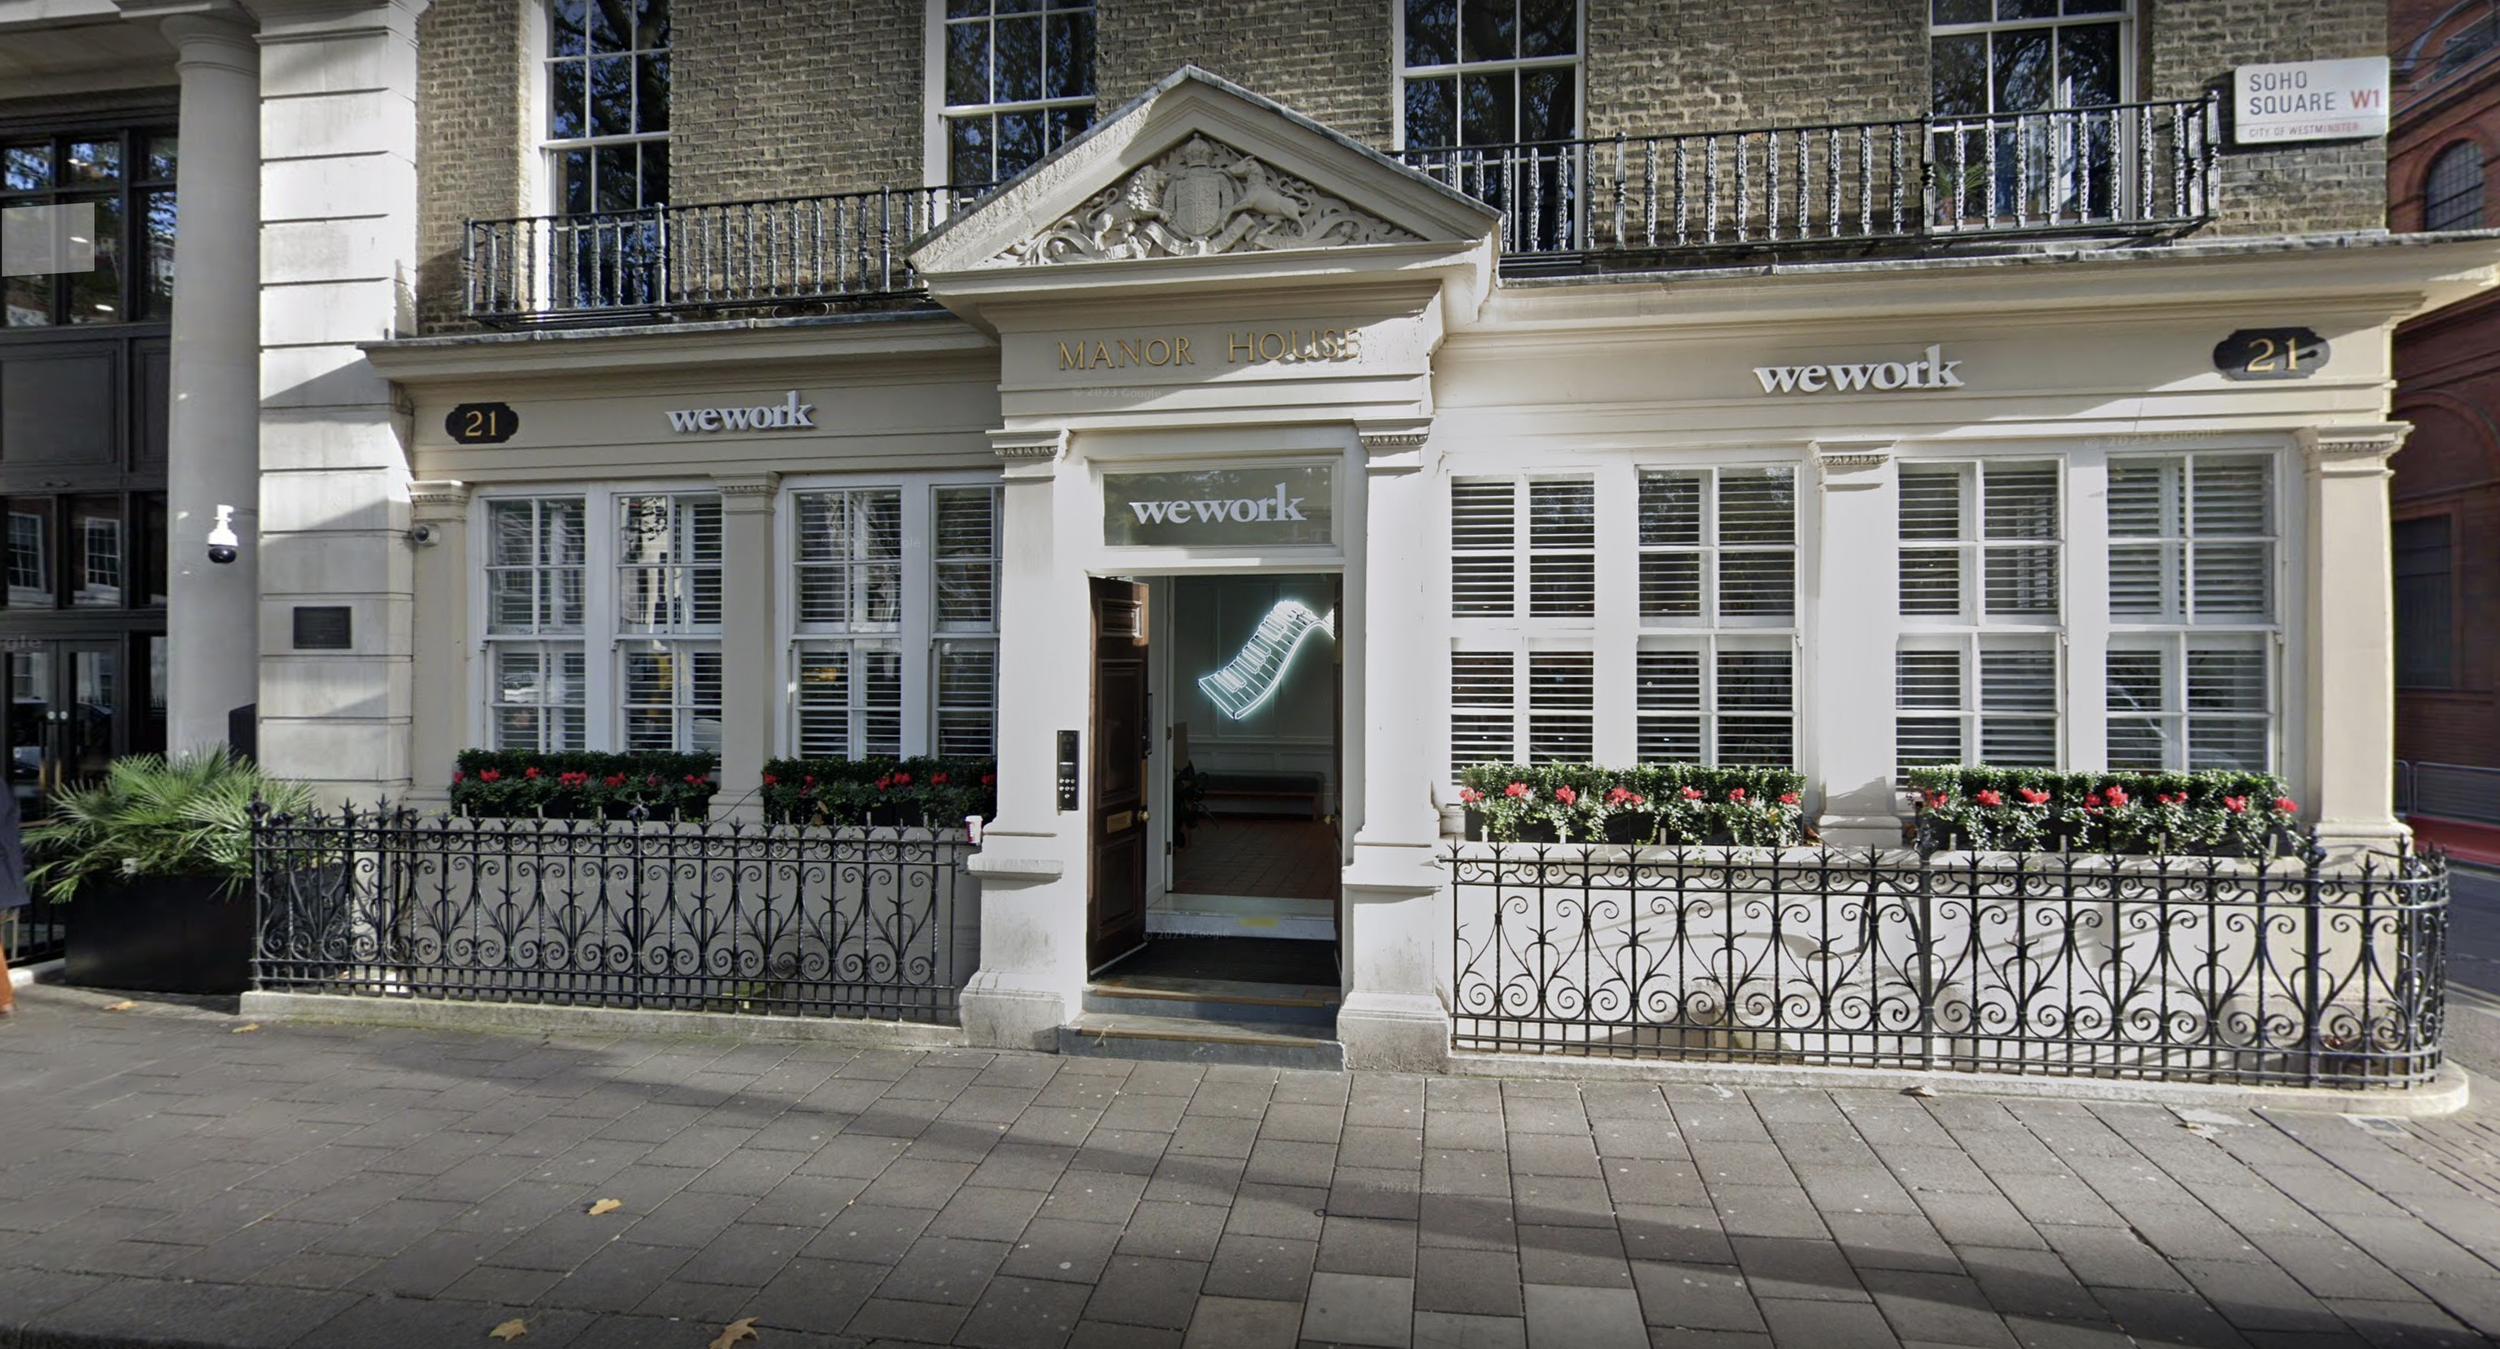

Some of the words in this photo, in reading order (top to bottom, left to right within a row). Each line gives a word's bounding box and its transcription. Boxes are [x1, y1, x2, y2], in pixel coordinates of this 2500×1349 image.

[2249, 70, 2307, 92] SOHO
[2249, 91, 2336, 115] SQUARE
[2350, 88, 2380, 109] W1
[2249, 127, 2270, 138] CITY
[2274, 126, 2286, 136] OF
[2289, 121, 2359, 135] WESTMINSTER
[1058, 337, 1194, 371] MANOR
[1227, 328, 1363, 364] HOUSE
[2246, 337, 2298, 372] 21
[1752, 343, 1965, 393] wework
[465, 410, 497, 437] 21
[664, 390, 814, 433] wework
[1128, 482, 1307, 525] wework
